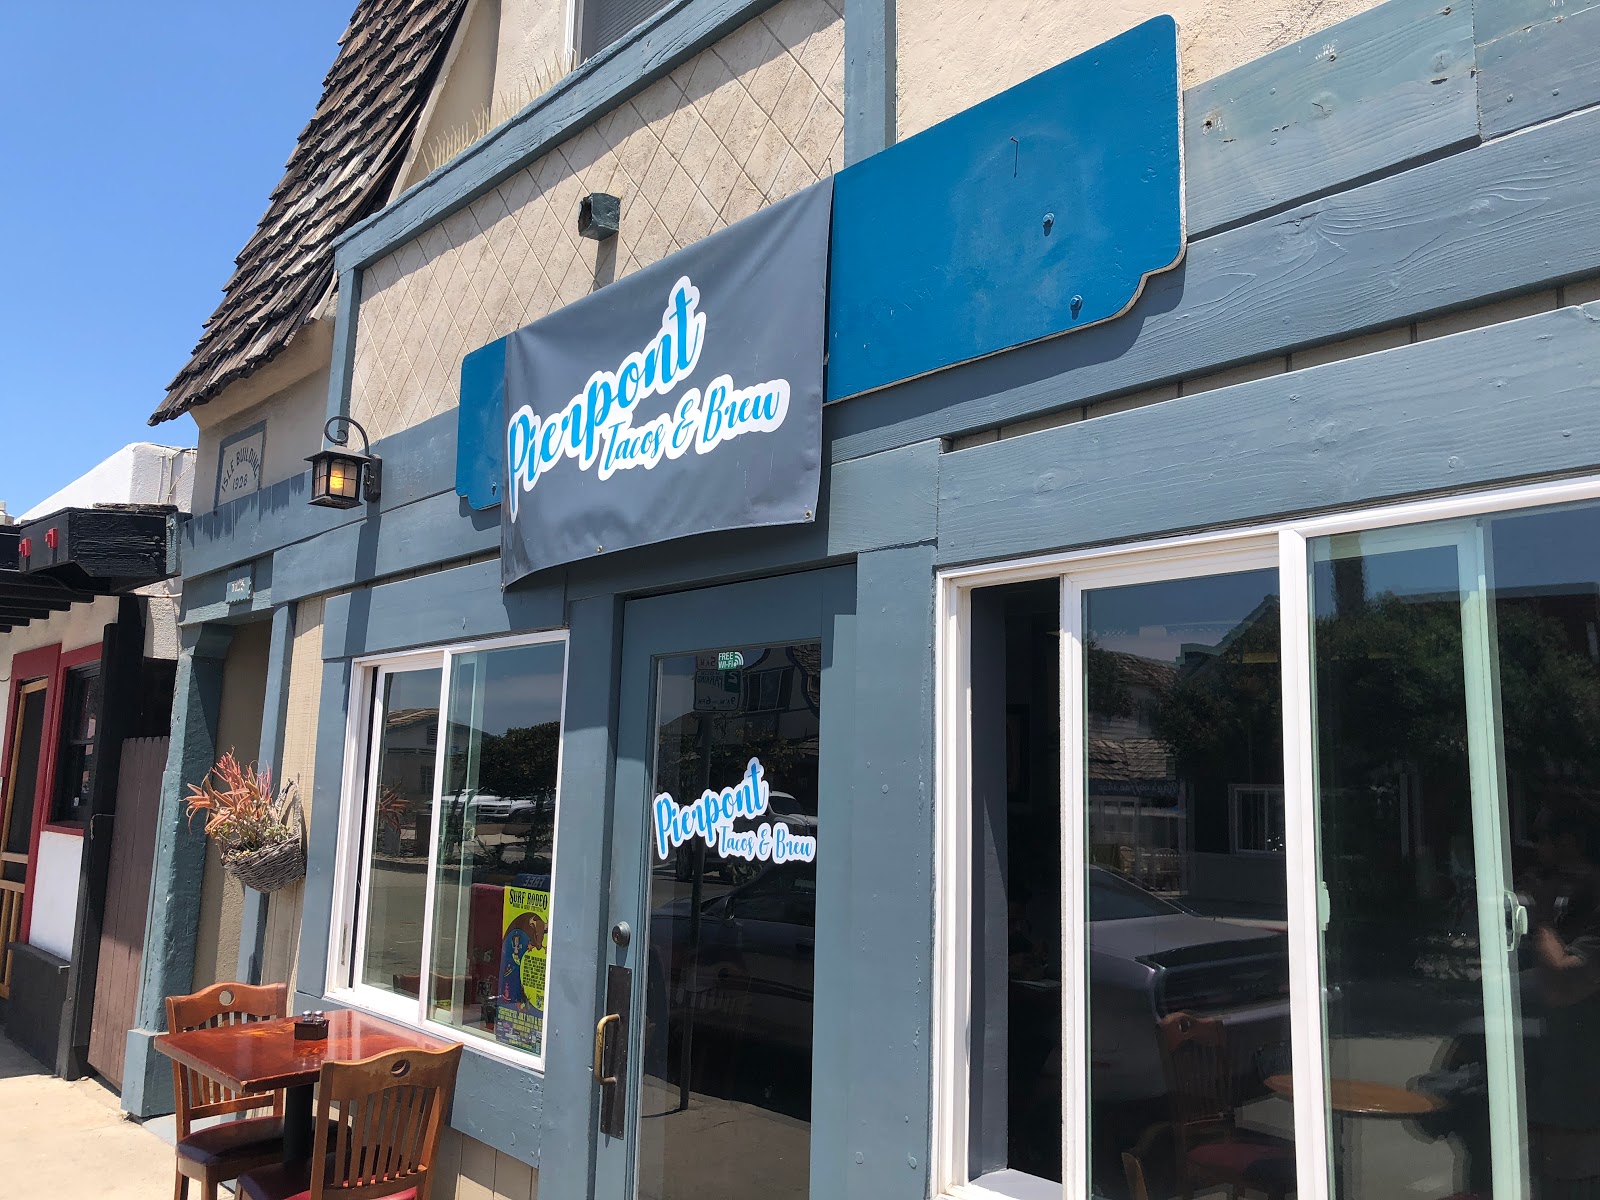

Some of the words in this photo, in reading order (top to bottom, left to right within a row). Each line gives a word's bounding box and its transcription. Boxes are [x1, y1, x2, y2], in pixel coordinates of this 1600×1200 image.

[508, 284, 701, 516] Pierpont
[603, 420, 666, 471] Tacos
[672, 398, 695, 449] &
[702, 385, 780, 444] Brew
[236, 447, 260, 479] BUILDING
[718, 651, 733, 660] FREE
[718, 660, 735, 669] WI-FI
[656, 762, 766, 855] Pierpont
[720, 825, 755, 856] Tacos
[759, 828, 770, 855] &
[776, 828, 813, 858] Brew
[509, 888, 526, 905] SURF
[527, 892, 548, 910] RODEO
